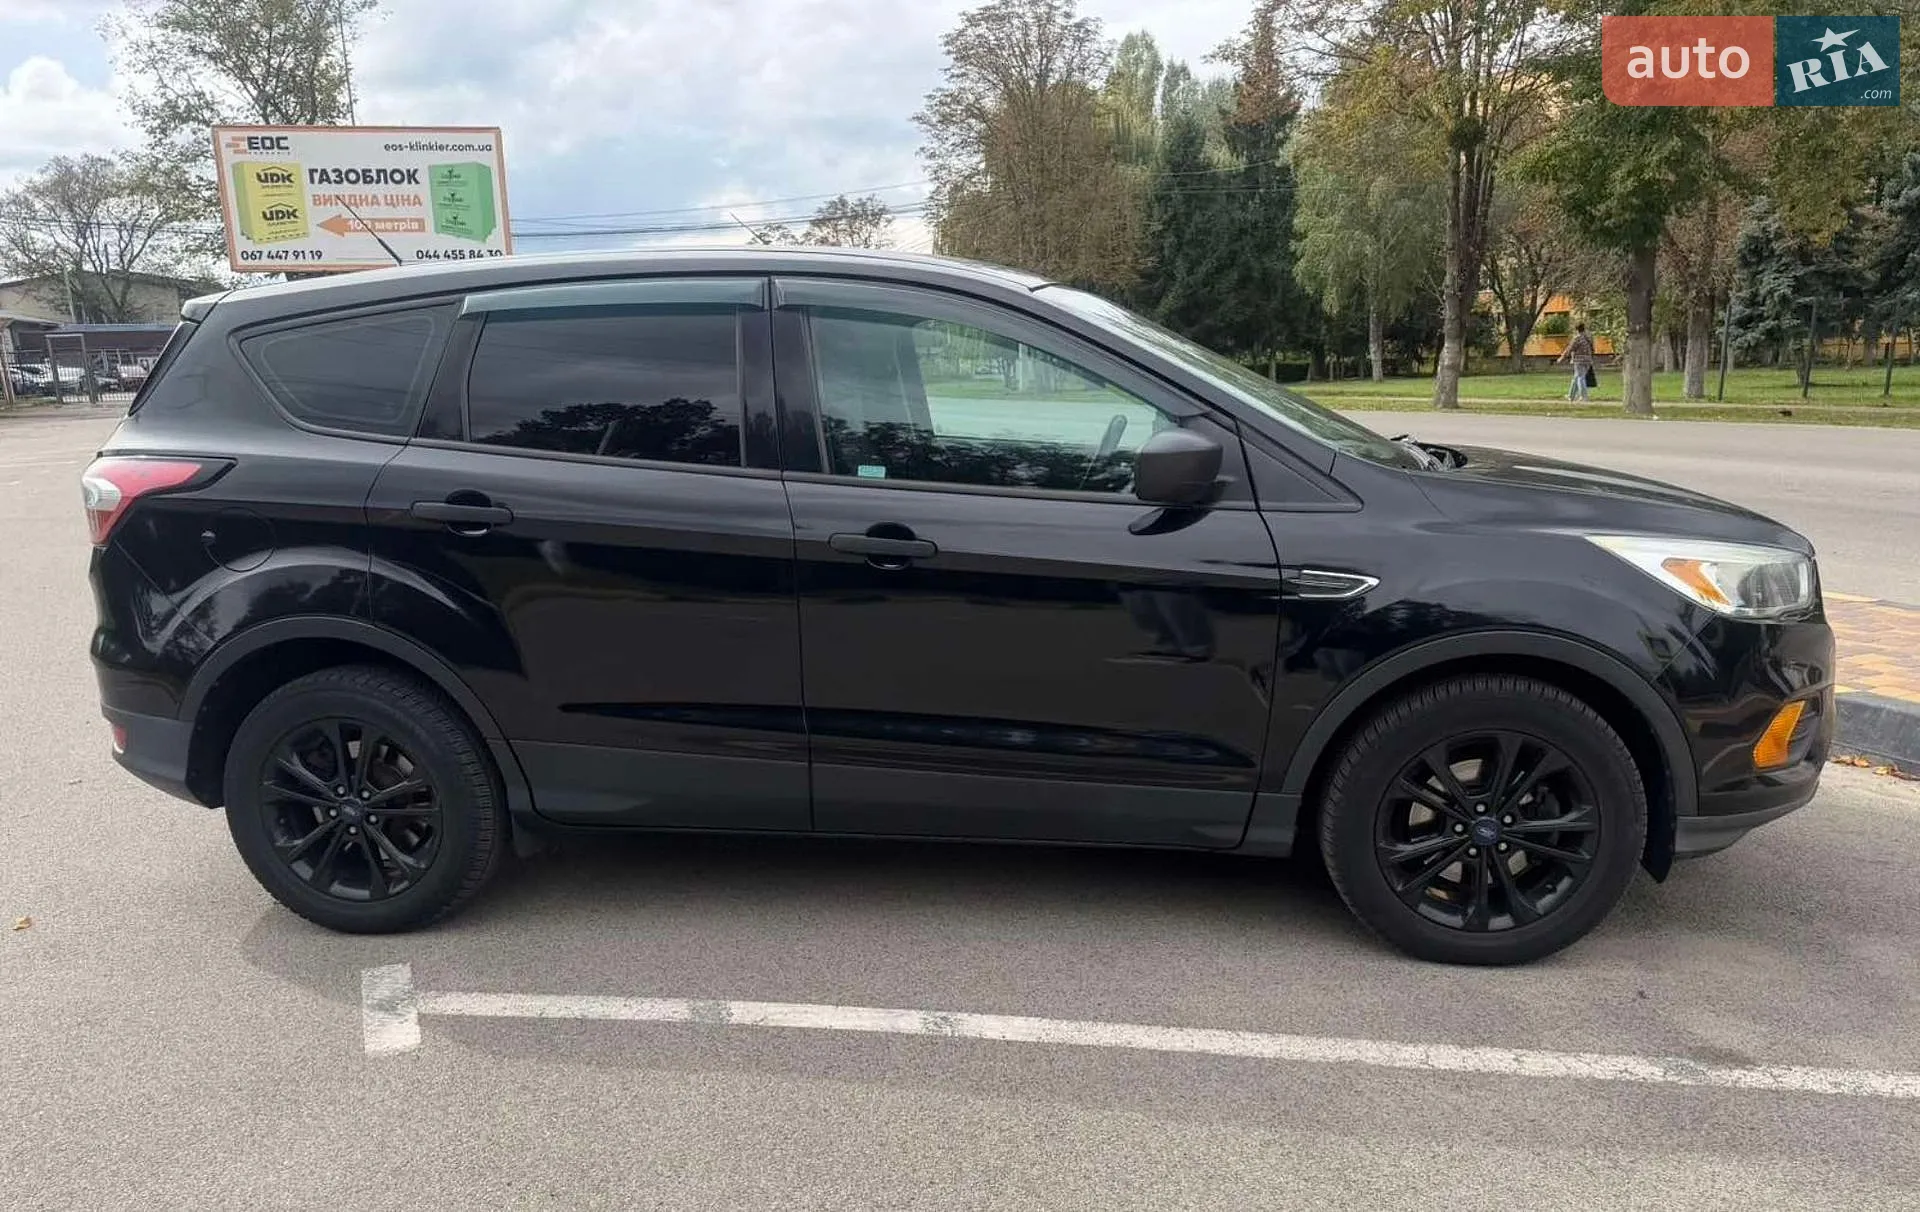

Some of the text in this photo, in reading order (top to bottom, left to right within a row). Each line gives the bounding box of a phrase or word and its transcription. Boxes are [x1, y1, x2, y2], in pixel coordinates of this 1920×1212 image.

[383, 140, 493, 152] eos-klinkier.com.ua
[256, 172, 295, 184] UDK
[308, 167, 421, 185] ГАЗОБЛОК
[383, 193, 423, 208] ЦІНА
[262, 208, 299, 221] UDK
[374, 218, 419, 231] метрів
[240, 249, 323, 261] 067 447 91 19
[415, 249, 440, 260] 044
[443, 248, 466, 260] 455
